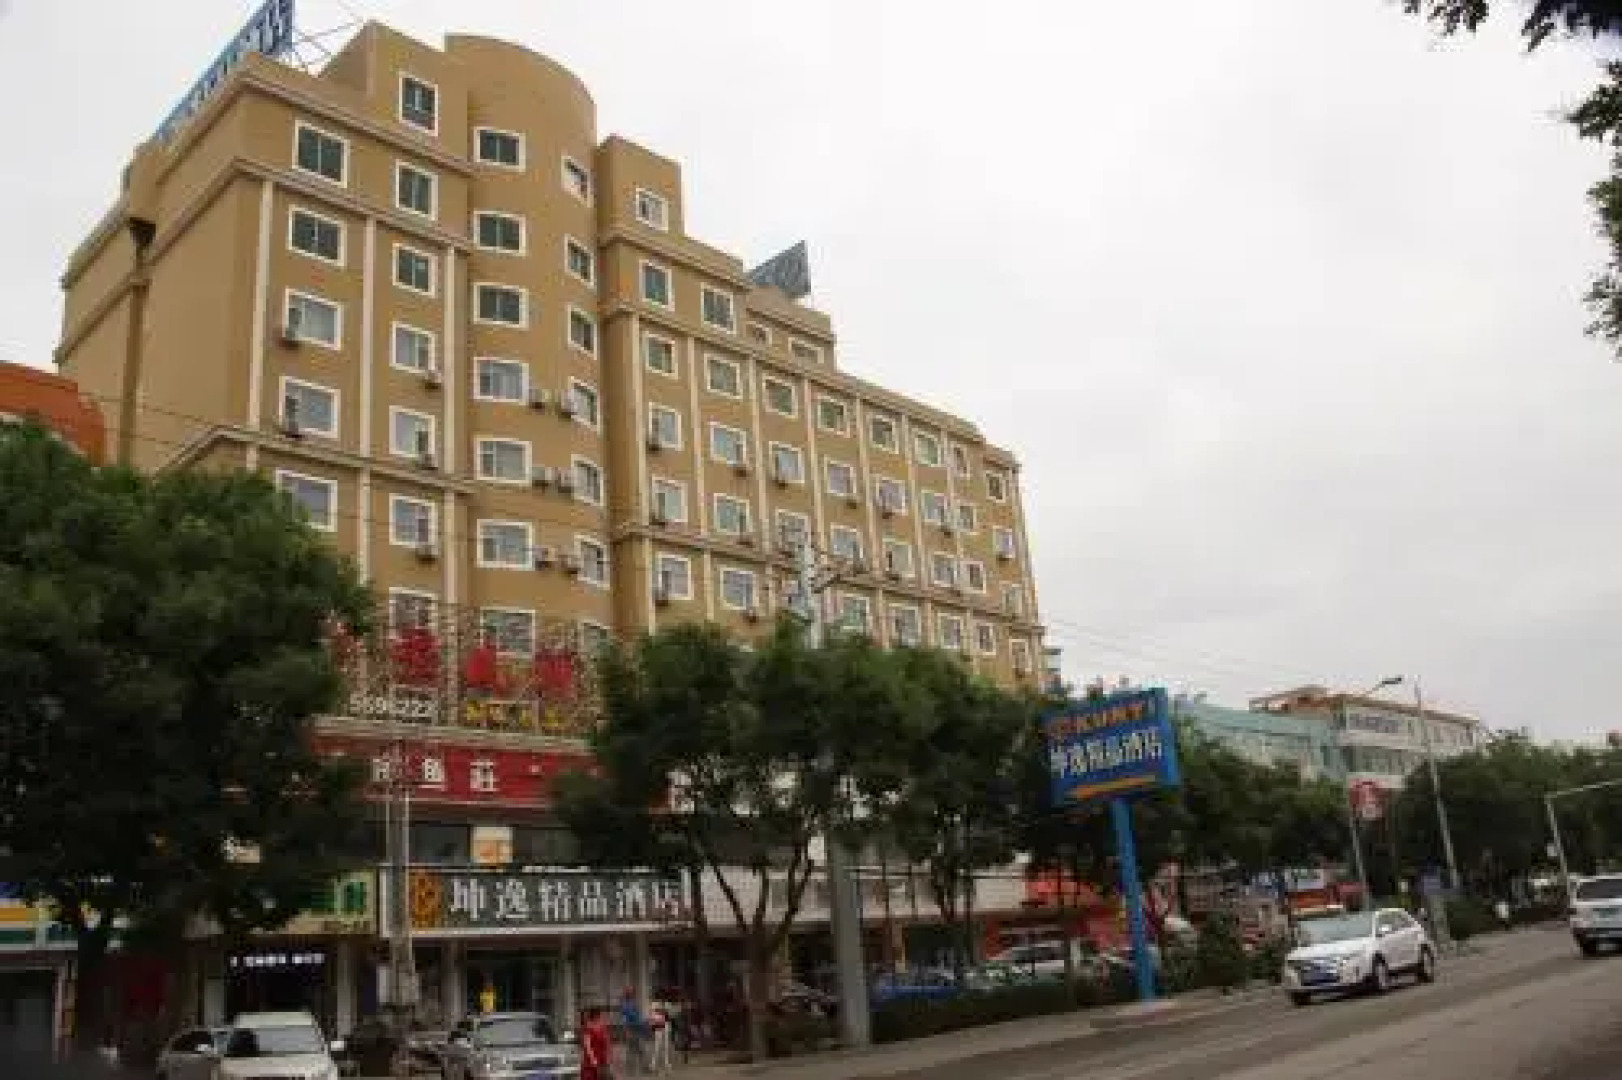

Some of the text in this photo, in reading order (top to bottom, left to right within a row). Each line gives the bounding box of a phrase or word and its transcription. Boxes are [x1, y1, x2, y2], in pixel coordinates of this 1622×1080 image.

[450, 878, 681, 921] 坤逸精品酒店
